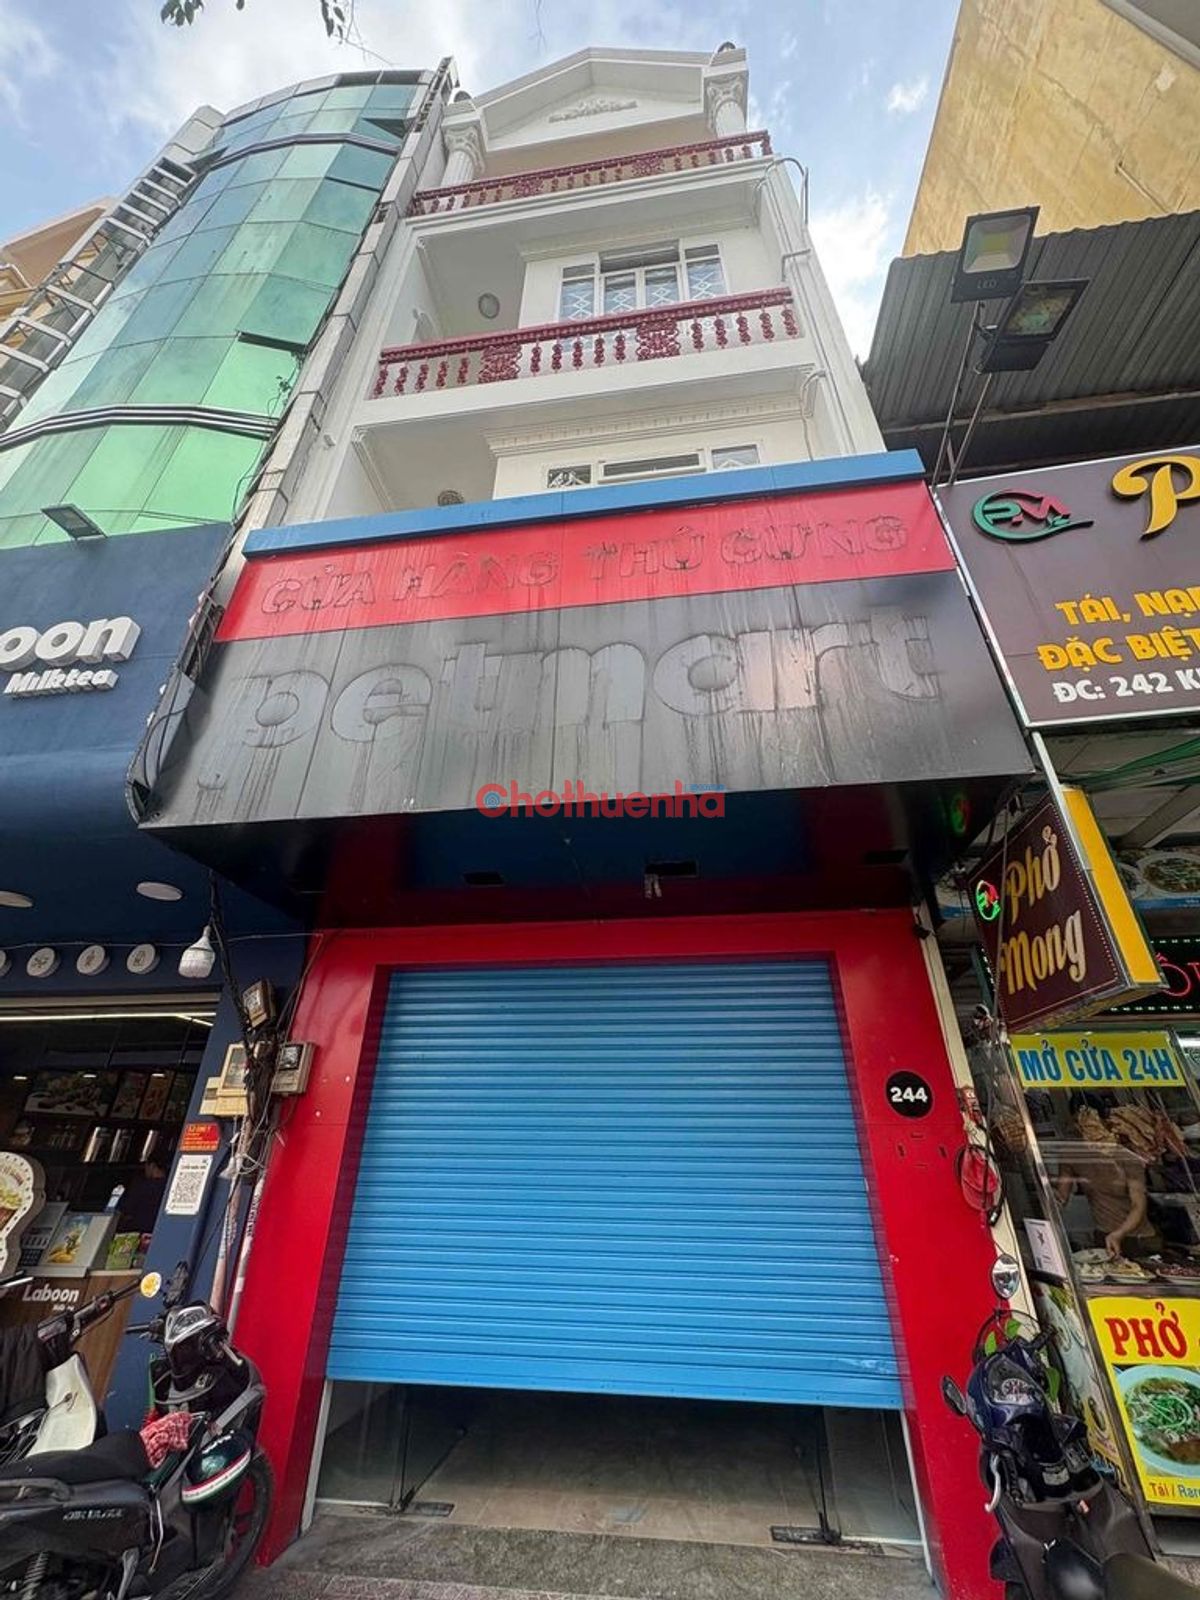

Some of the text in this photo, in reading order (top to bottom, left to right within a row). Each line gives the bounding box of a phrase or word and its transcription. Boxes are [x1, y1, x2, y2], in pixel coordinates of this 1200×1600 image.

[197, 614, 940, 790] petmart
[1110, 671, 1174, 698] 242
[1018, 1039, 1178, 1082] MỞ CỬA 24H
[890, 1086, 928, 1102] 244
[22, 1284, 80, 1303] Laboon
[1105, 1301, 1188, 1359] PHỞ
